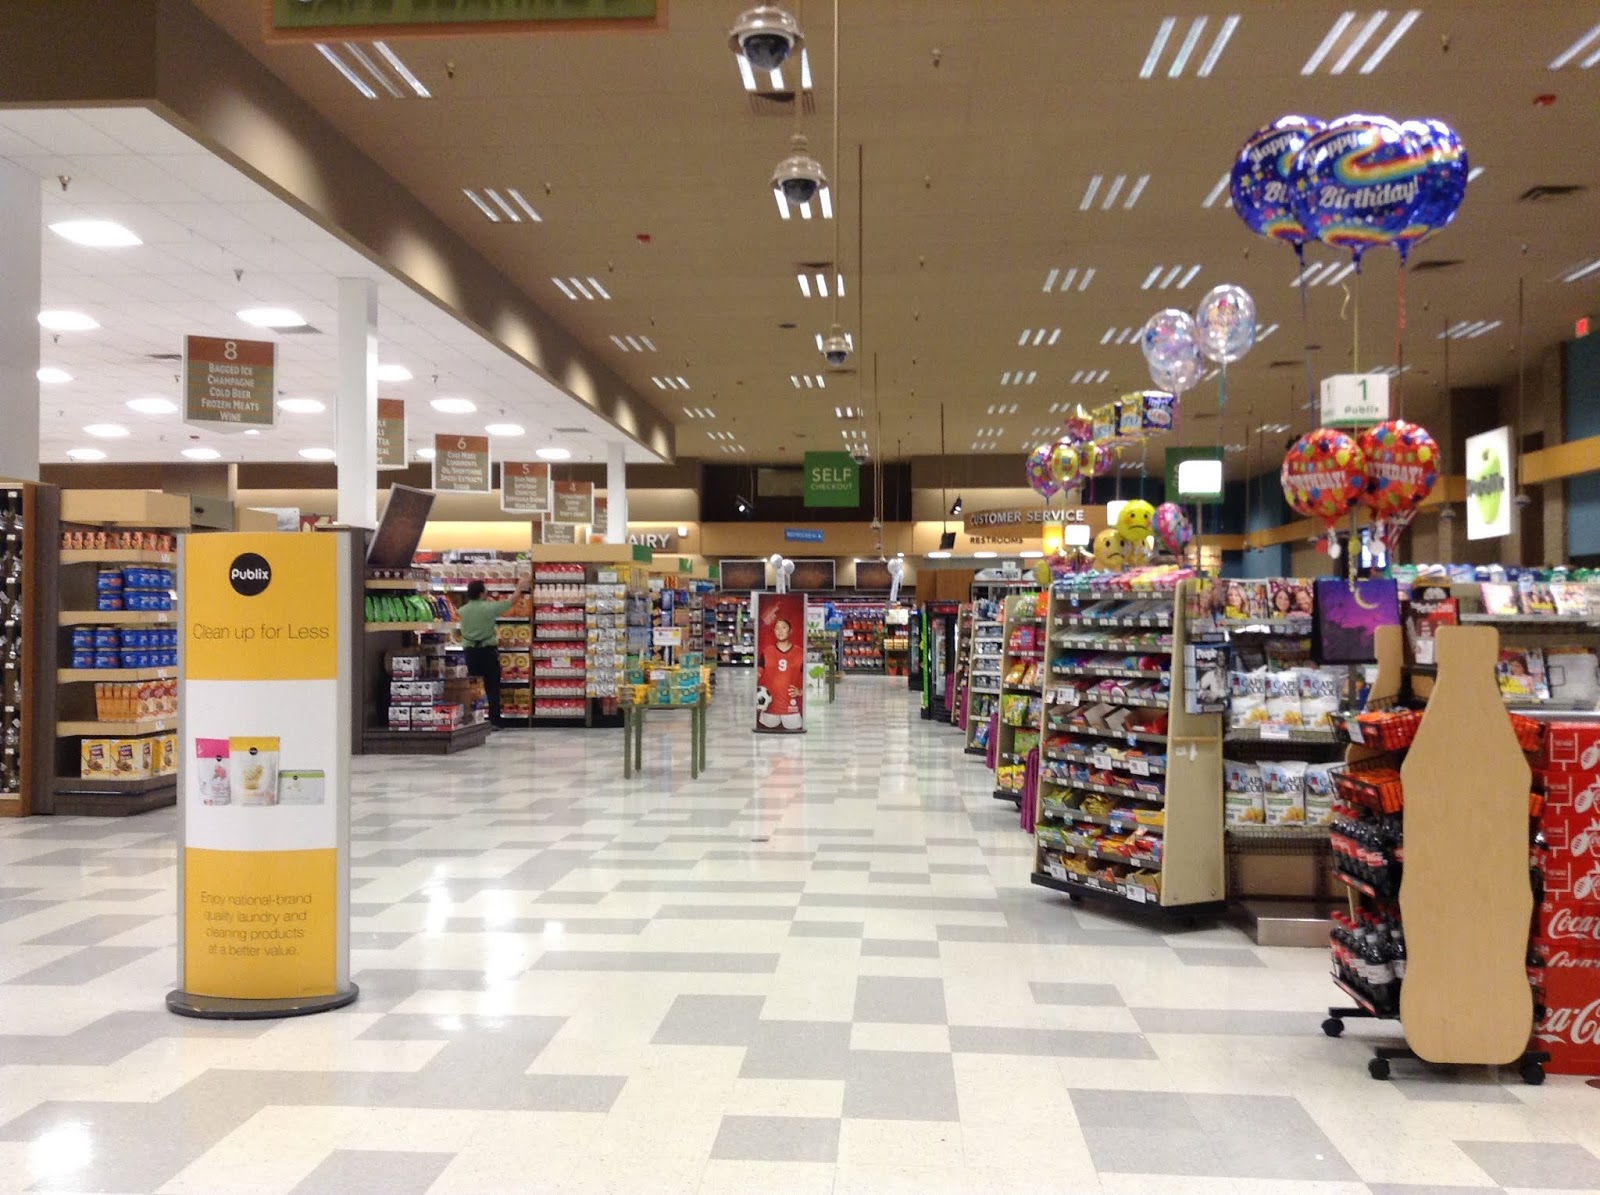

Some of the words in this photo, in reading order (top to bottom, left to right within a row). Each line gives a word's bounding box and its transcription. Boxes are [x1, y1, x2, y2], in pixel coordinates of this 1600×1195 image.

[1319, 174, 1419, 210] Birthday!
[224, 341, 238, 360] 8
[208, 362, 240, 375] BAGGED
[240, 366, 254, 376] ICE
[207, 374, 255, 388] CHAMPAGNE
[209, 386, 231, 397] COLD
[232, 388, 251, 399] BEER
[1358, 379, 1368, 401] 1
[201, 398, 231, 409] FROZEN
[233, 400, 260, 412] MEATS
[219, 411, 242, 421] WINE
[457, 437, 467, 450] 6
[522, 463, 530, 475] 5
[812, 467, 852, 482] SELF
[569, 482, 577, 493] 4
[810, 483, 852, 491] CHECKOUT
[970, 511, 1022, 526] CUSTOMER
[1026, 509, 1085, 523] SERVICE
[628, 533, 670, 549] AIRY
[969, 536, 1024, 545] RESTROOMS
[231, 568, 269, 580] Publix
[192, 623, 230, 640] Clean
[234, 627, 256, 642] up
[261, 623, 283, 640] for
[288, 623, 330, 640] Less
[777, 658, 788, 672] 9
[228, 893, 312, 906] national-brand
[237, 910, 280, 925] laundry
[283, 910, 307, 922] and
[206, 926, 247, 942] cleaning
[250, 928, 305, 942] products
[208, 943, 218, 955] at
[219, 946, 226, 955] a
[229, 944, 260, 956] better
